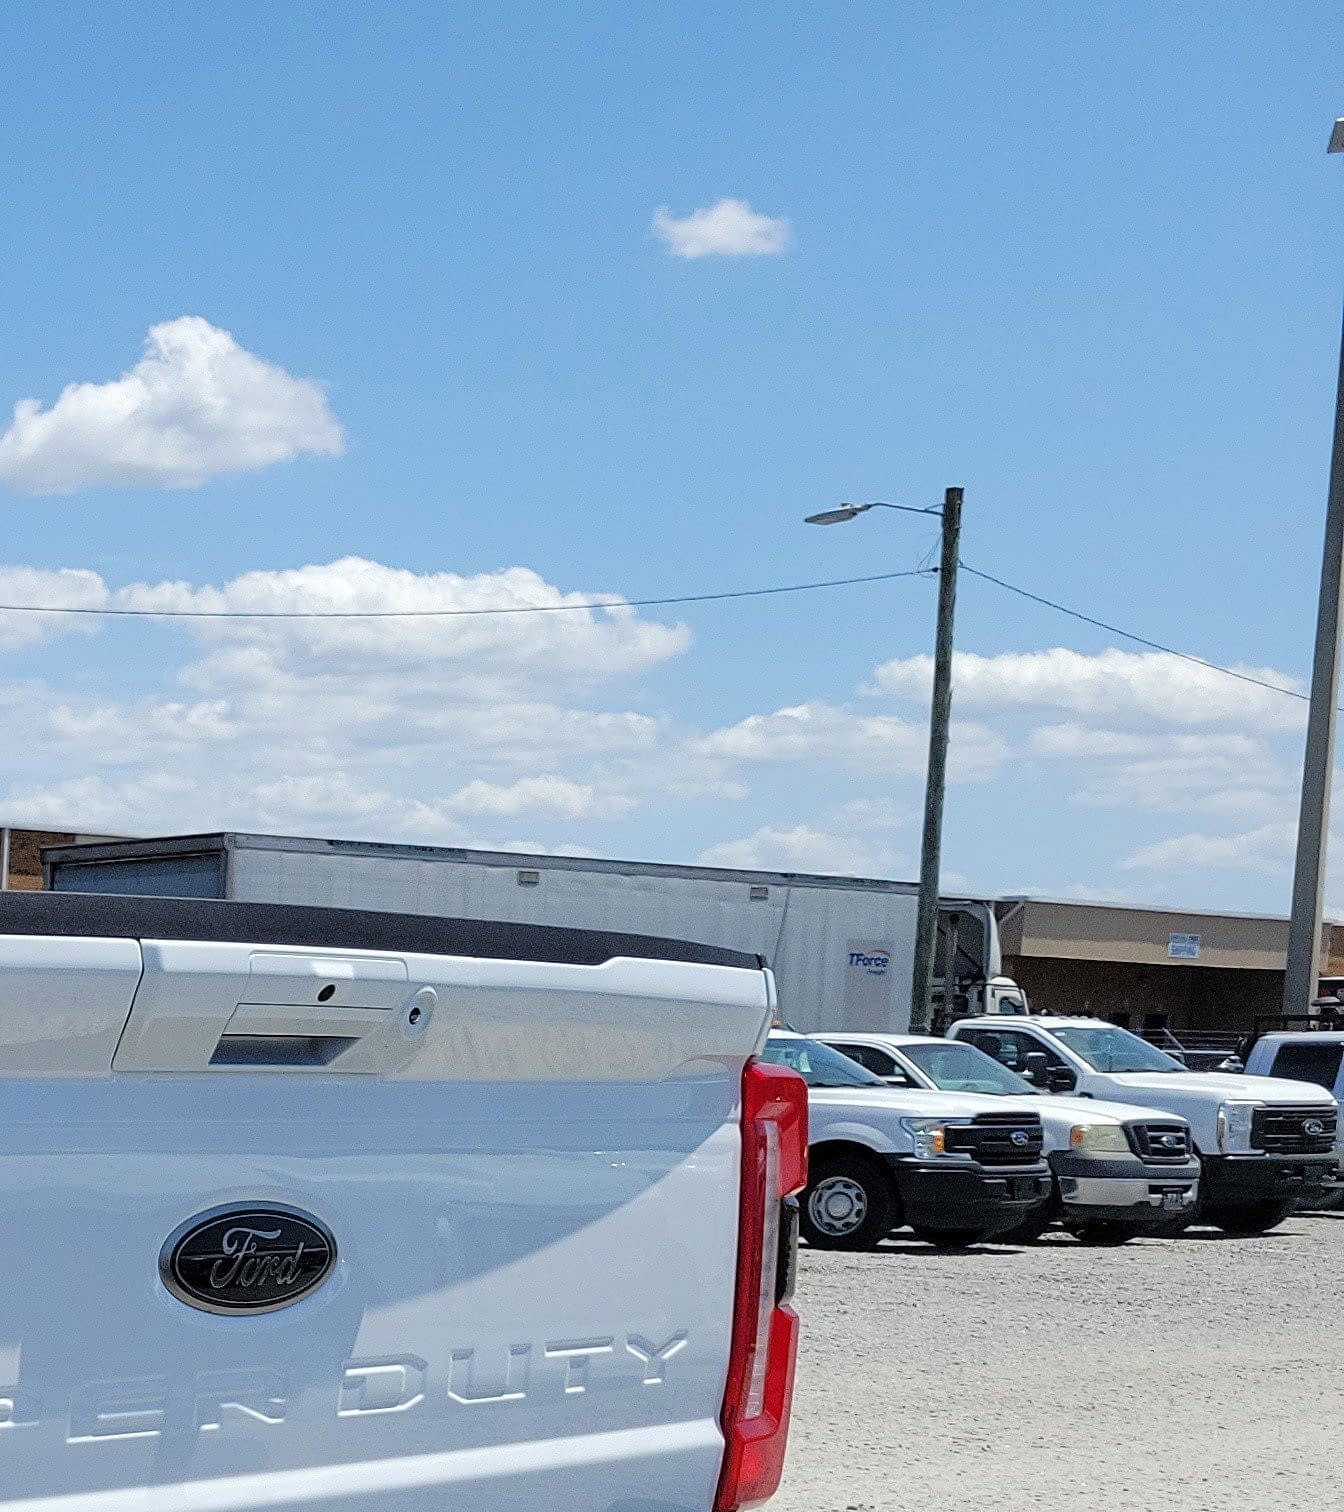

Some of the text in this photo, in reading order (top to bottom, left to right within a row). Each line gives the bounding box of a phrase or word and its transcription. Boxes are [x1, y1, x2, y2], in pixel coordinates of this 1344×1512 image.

[848, 952, 890, 968] TForce
[210, 1227, 305, 1289] Ford
[337, 1328, 690, 1418] DUTY
